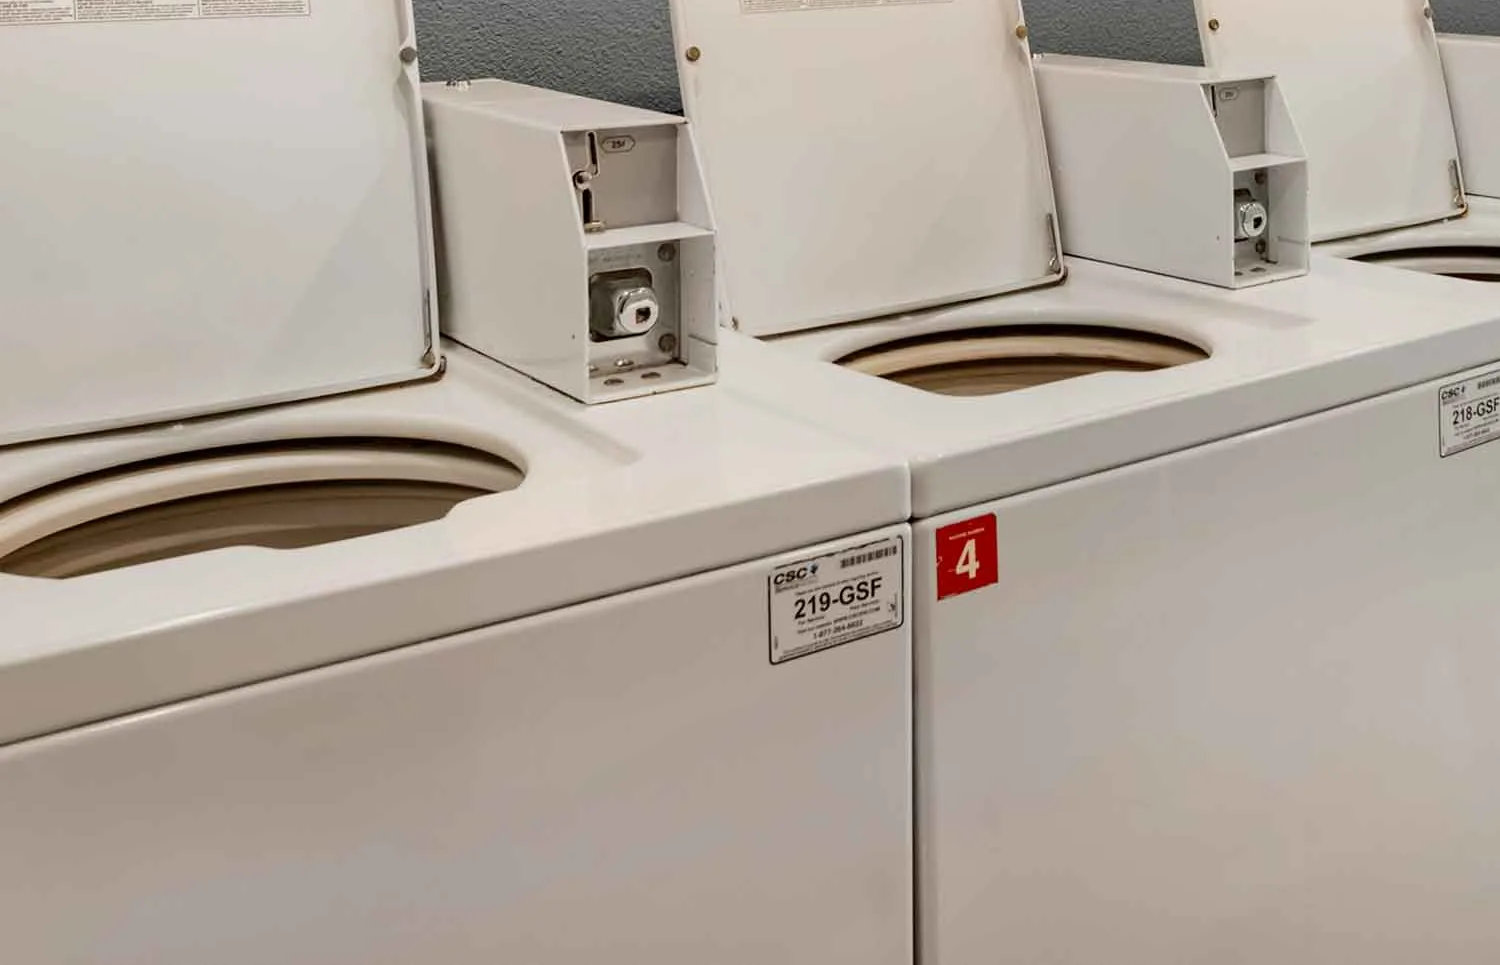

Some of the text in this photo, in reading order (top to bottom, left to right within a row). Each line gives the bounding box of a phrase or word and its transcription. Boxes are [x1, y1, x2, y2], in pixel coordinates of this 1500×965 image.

[1441, 387, 1460, 400] CSC
[1453, 396, 1500, 426] 218-GSF
[956, 538, 980, 579] 4
[774, 567, 808, 585] CSC
[794, 576, 883, 620] 219-GSF
